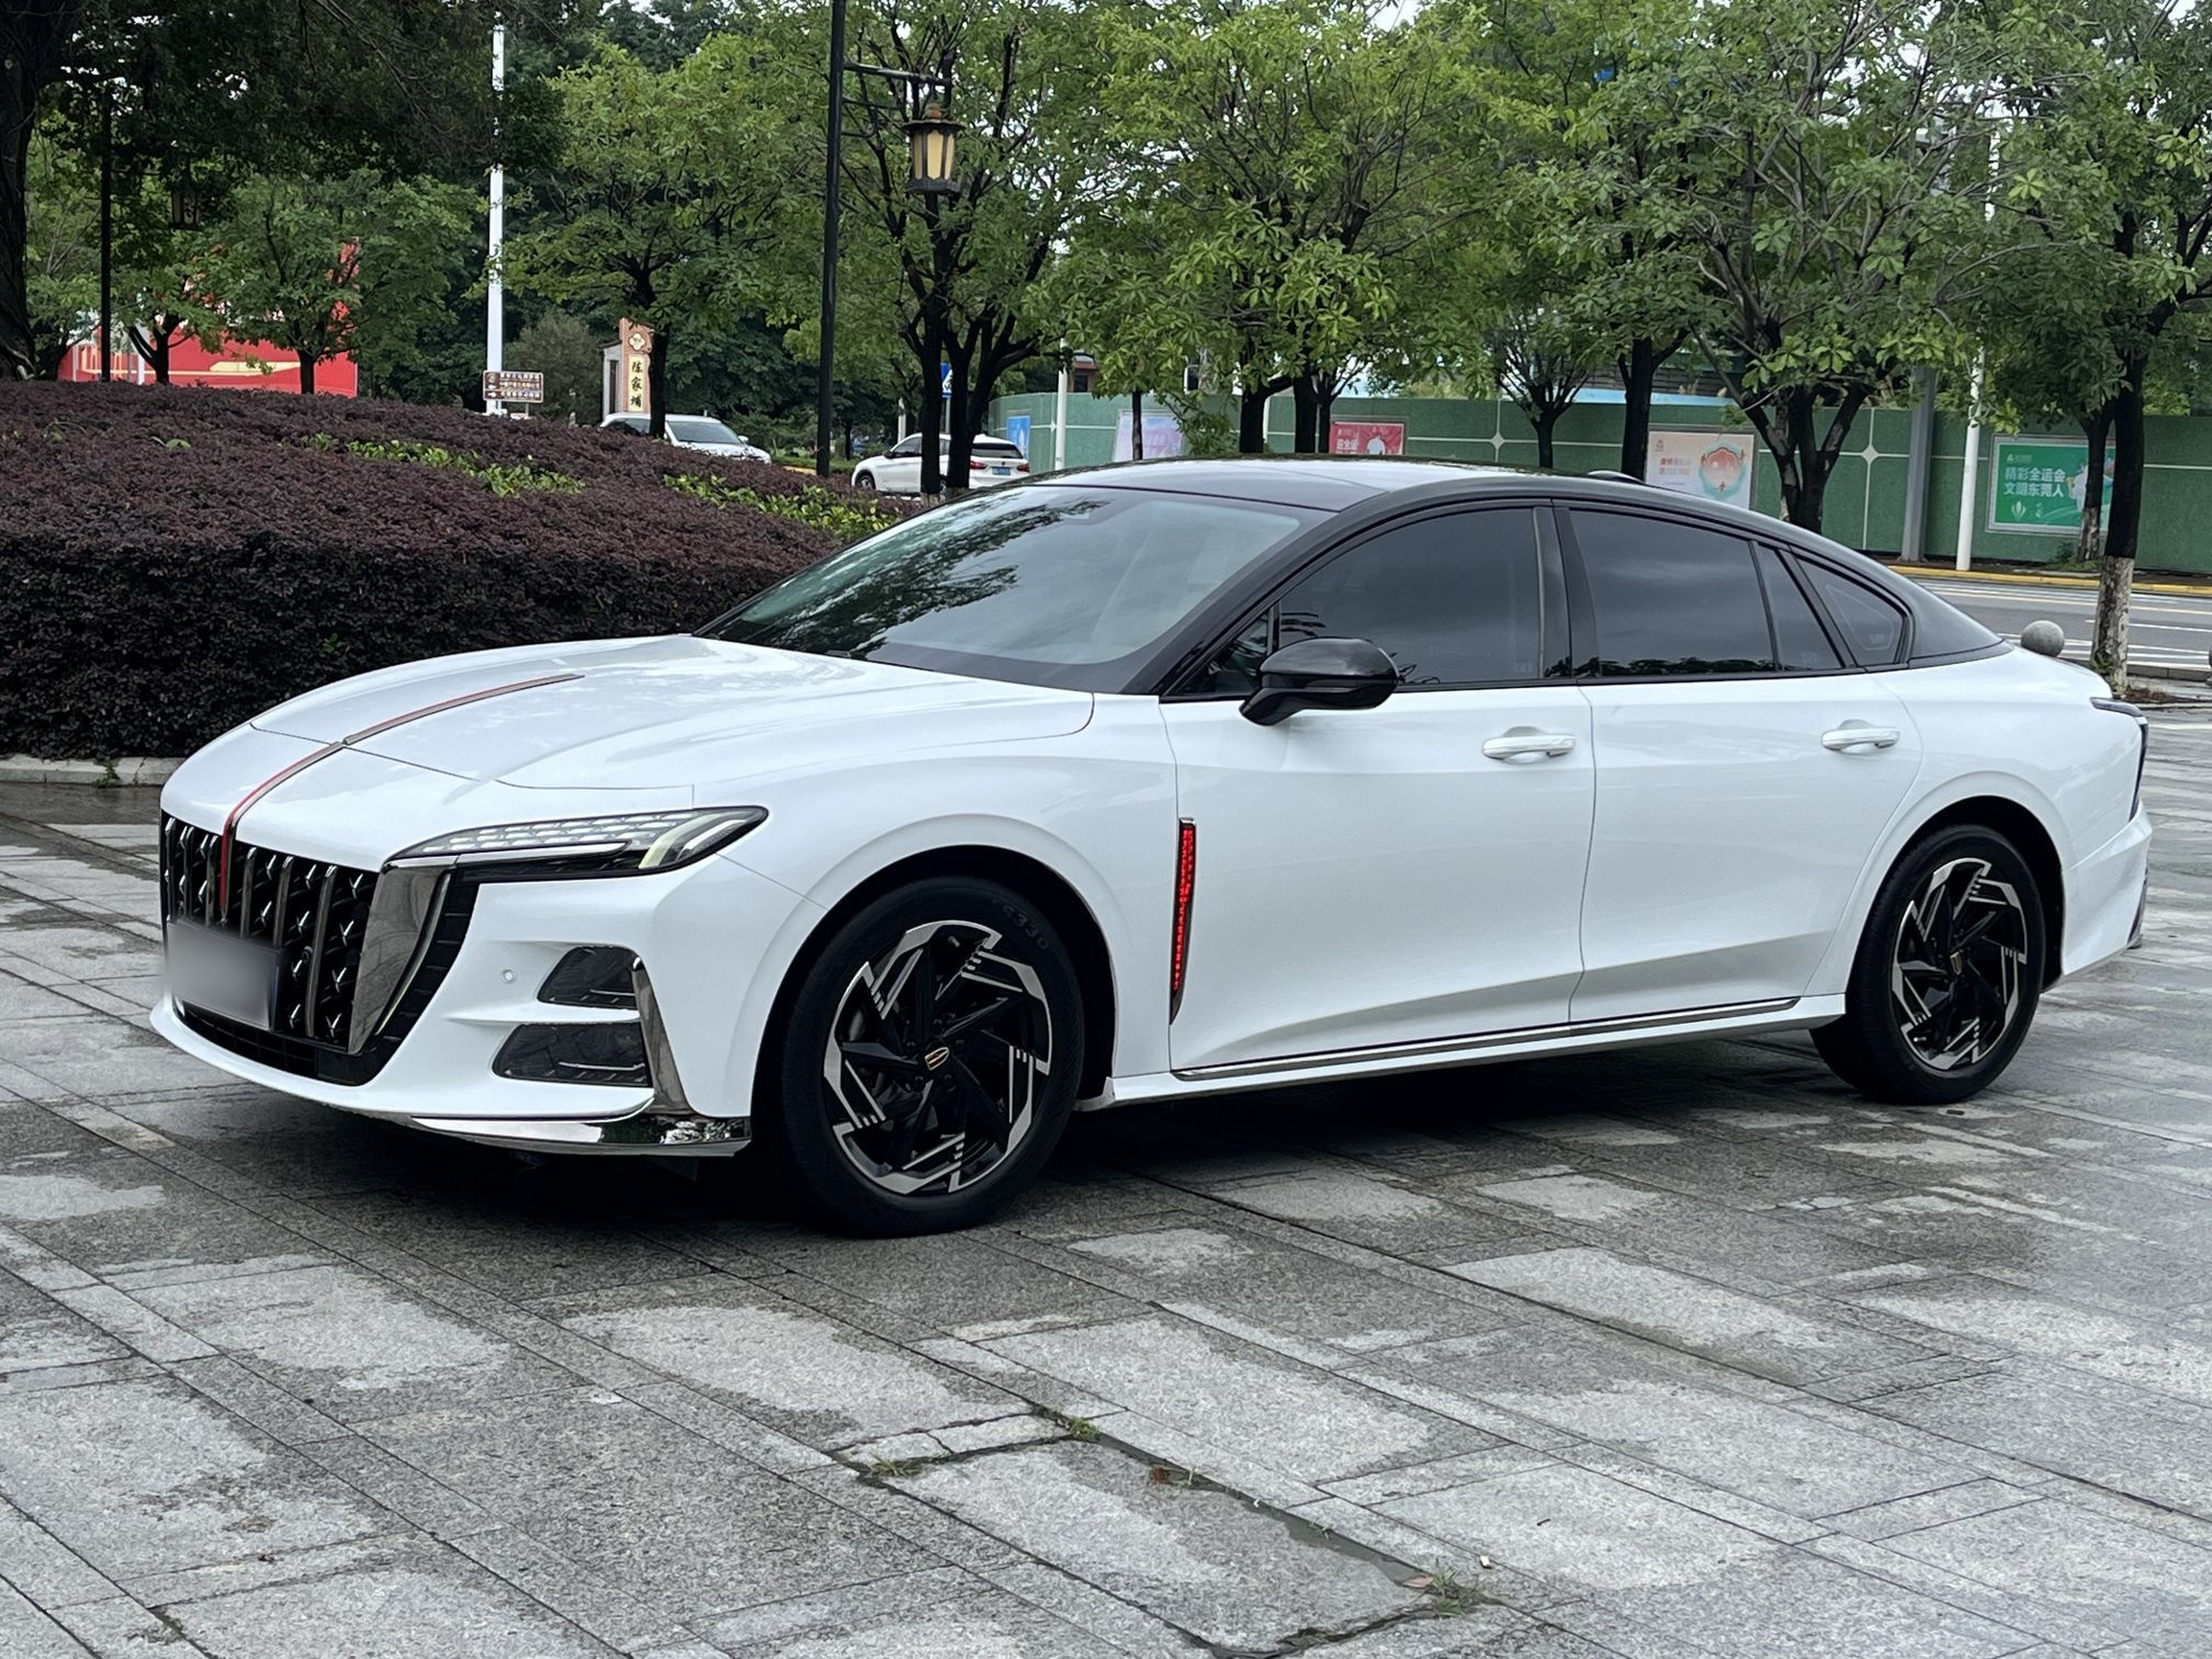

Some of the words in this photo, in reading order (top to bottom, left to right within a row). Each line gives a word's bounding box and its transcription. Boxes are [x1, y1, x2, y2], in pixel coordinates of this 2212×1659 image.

[2005, 467, 2066, 483] 精彩全运会
[2004, 482, 2064, 498] 文明东莞人
